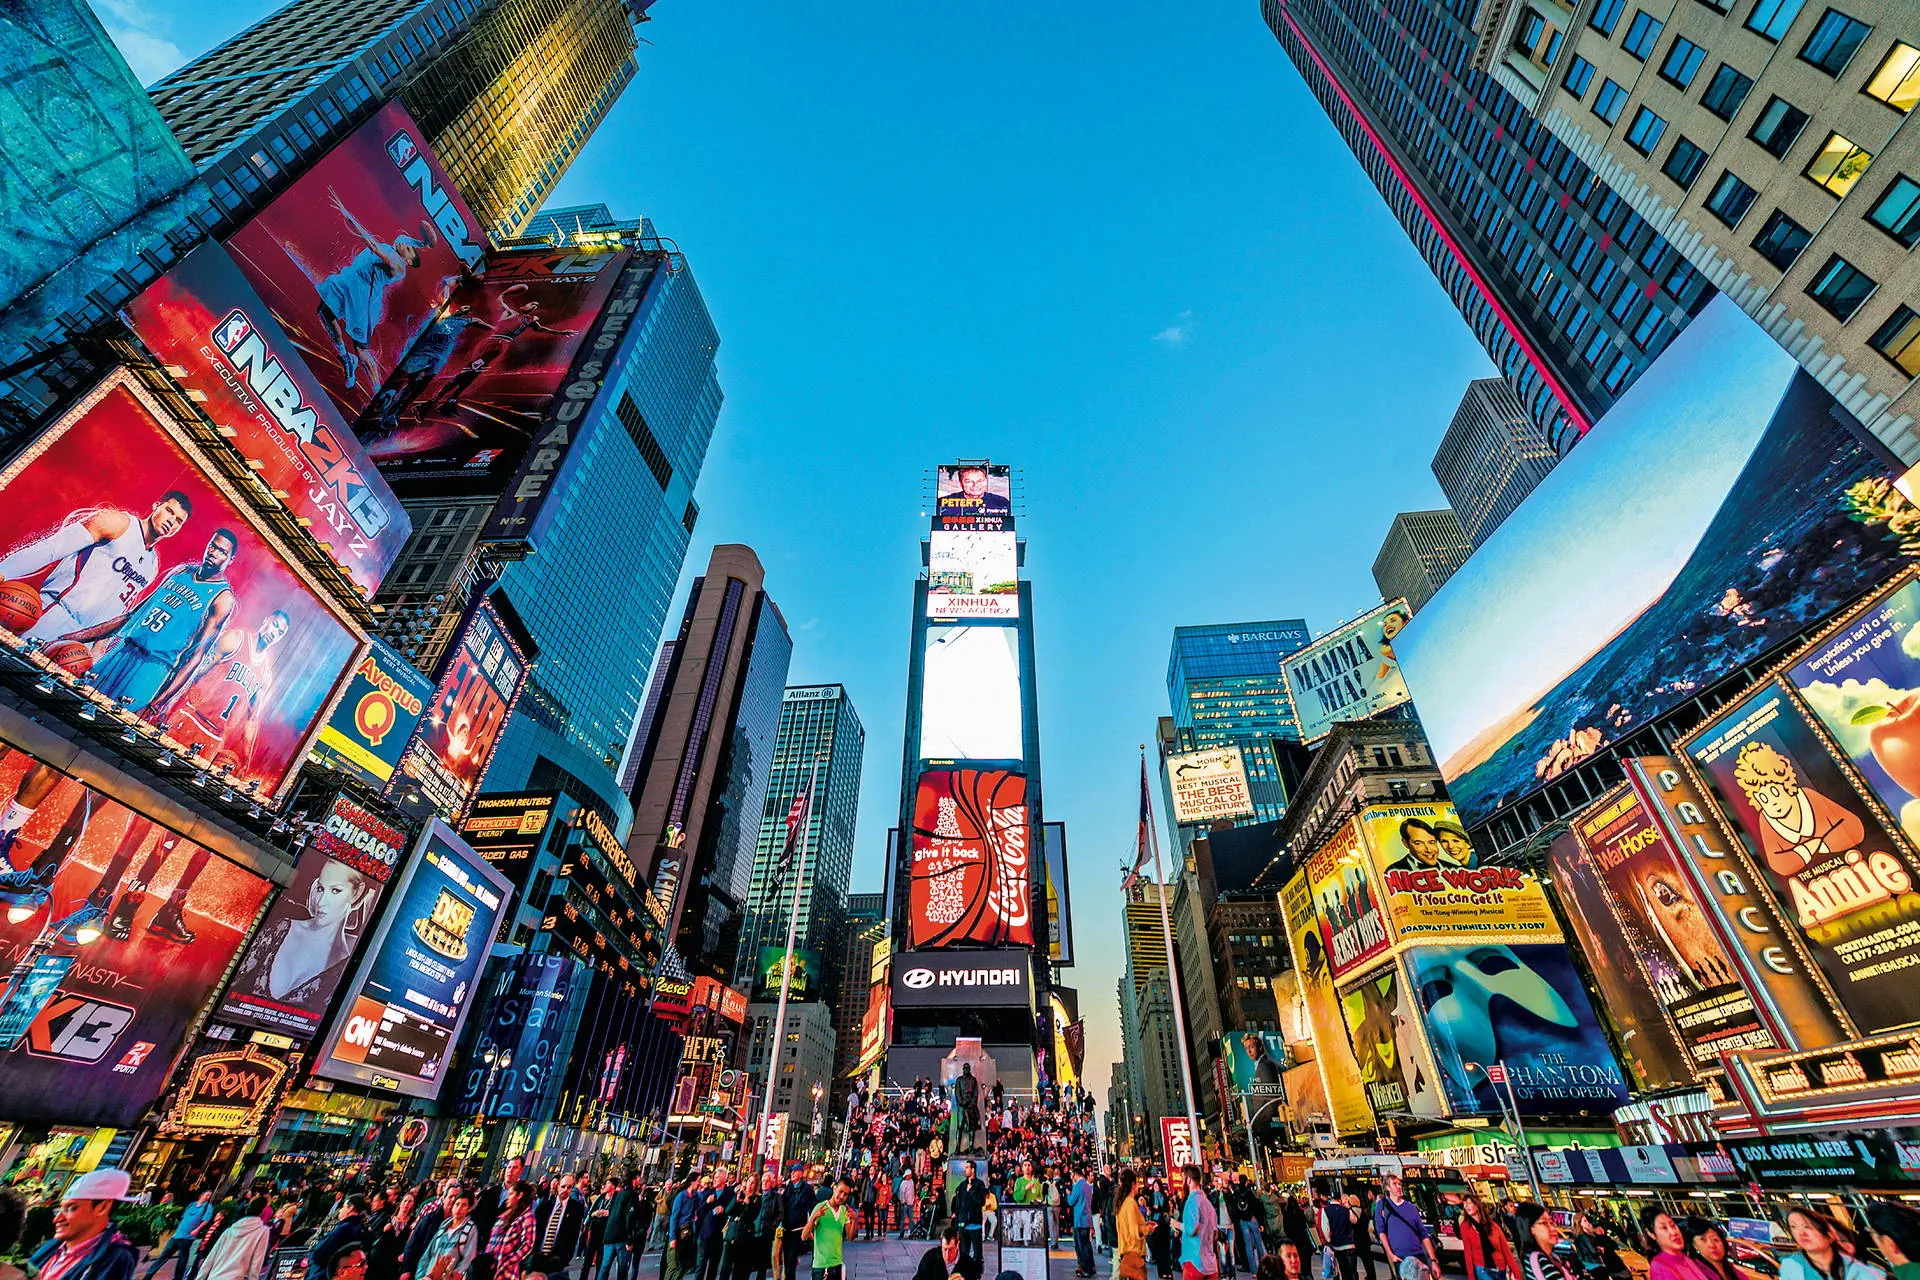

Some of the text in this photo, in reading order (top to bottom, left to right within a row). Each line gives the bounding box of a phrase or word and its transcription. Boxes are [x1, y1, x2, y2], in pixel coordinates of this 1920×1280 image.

[594, 268, 653, 351] TIMES
[200, 346, 318, 484] EXECUTIVE PRODUCED BY
[514, 361, 603, 498] SQUARE
[941, 498, 975, 508] PETER
[308, 484, 369, 559] JAY Z
[500, 517, 527, 525] NYC
[943, 523, 1003, 531] GALLERY
[976, 516, 1003, 524] XINHUA
[112, 556, 149, 588] Clippers
[162, 593, 184, 611] CITY
[947, 598, 999, 607] XINHUA
[140, 607, 174, 634] 35
[1242, 629, 1302, 643] BARCLAYS
[1807, 635, 1853, 673] Temptation
[1851, 621, 1873, 641] isn't
[1871, 618, 1881, 629] a
[1823, 620, 1908, 678] Unless you give in.
[382, 656, 416, 686] BEST MUSICAL
[1292, 635, 1375, 696] MAMMA
[357, 655, 422, 717] Avenue
[1315, 669, 1368, 717] MIA!
[220, 695, 239, 719] 1
[354, 690, 396, 747] Q
[432, 645, 507, 769] EVITA
[1177, 776, 1242, 791] BEST MUSICAL
[1207, 783, 1242, 797] BEST
[478, 797, 552, 809] THOMSON REUTERS
[1180, 793, 1245, 809] MUSICAL OF
[1182, 806, 1202, 815] THIS
[469, 818, 520, 829] COMMODITIES
[476, 829, 505, 838] ENERGY
[326, 814, 399, 867] CHICAGO
[585, 810, 638, 889] CONFERENCE CALL
[1309, 823, 1356, 873] THE CROWD
[508, 849, 529, 860] GAS
[914, 847, 980, 860] give it back
[560, 864, 575, 876] 5
[1313, 859, 1335, 885] GOES
[1656, 769, 1794, 976] PALACE
[1797, 856, 1845, 882] THE MUSICAL
[1383, 866, 1525, 898] NICE WORK
[1788, 849, 1912, 930] Annie
[1412, 892, 1505, 906] If You Can Get It
[431, 890, 475, 940] DISH
[541, 916, 558, 930] 3
[1420, 909, 1433, 917] The
[1434, 909, 1478, 918] Tony-Winning
[1479, 908, 1505, 916] Musical
[417, 917, 468, 957] NATION
[1331, 921, 1363, 969] JERSEY
[1357, 907, 1386, 955] BOYS
[1451, 921, 1545, 931] FUNNIEST LOVE STORY
[656, 977, 691, 995] Reese's
[939, 969, 1021, 986] HYUNDAI
[519, 988, 565, 1002] Morgan Stanley
[344, 1015, 378, 1048] CNN
[112, 1062, 138, 1074] SPORTS
[1540, 1052, 1570, 1065] THE
[199, 1063, 271, 1100] ROXY
[1506, 1065, 1621, 1086] PHANTOM
[1769, 1071, 1811, 1093] Annie
[1820, 1060, 1868, 1085] Annie
[1368, 1080, 1404, 1108] WICKED
[1517, 1086, 1617, 1100] OF THE OPERA
[190, 1111, 241, 1121] DELICATESSEN
[1169, 1122, 1192, 1168] tkts
[1449, 1141, 1476, 1165] sbarro
[1741, 1140, 1855, 1162] BOX OFFICE HERE
[270, 1154, 307, 1164] BLUE FIN
[1696, 1149, 1736, 1174] Annie
